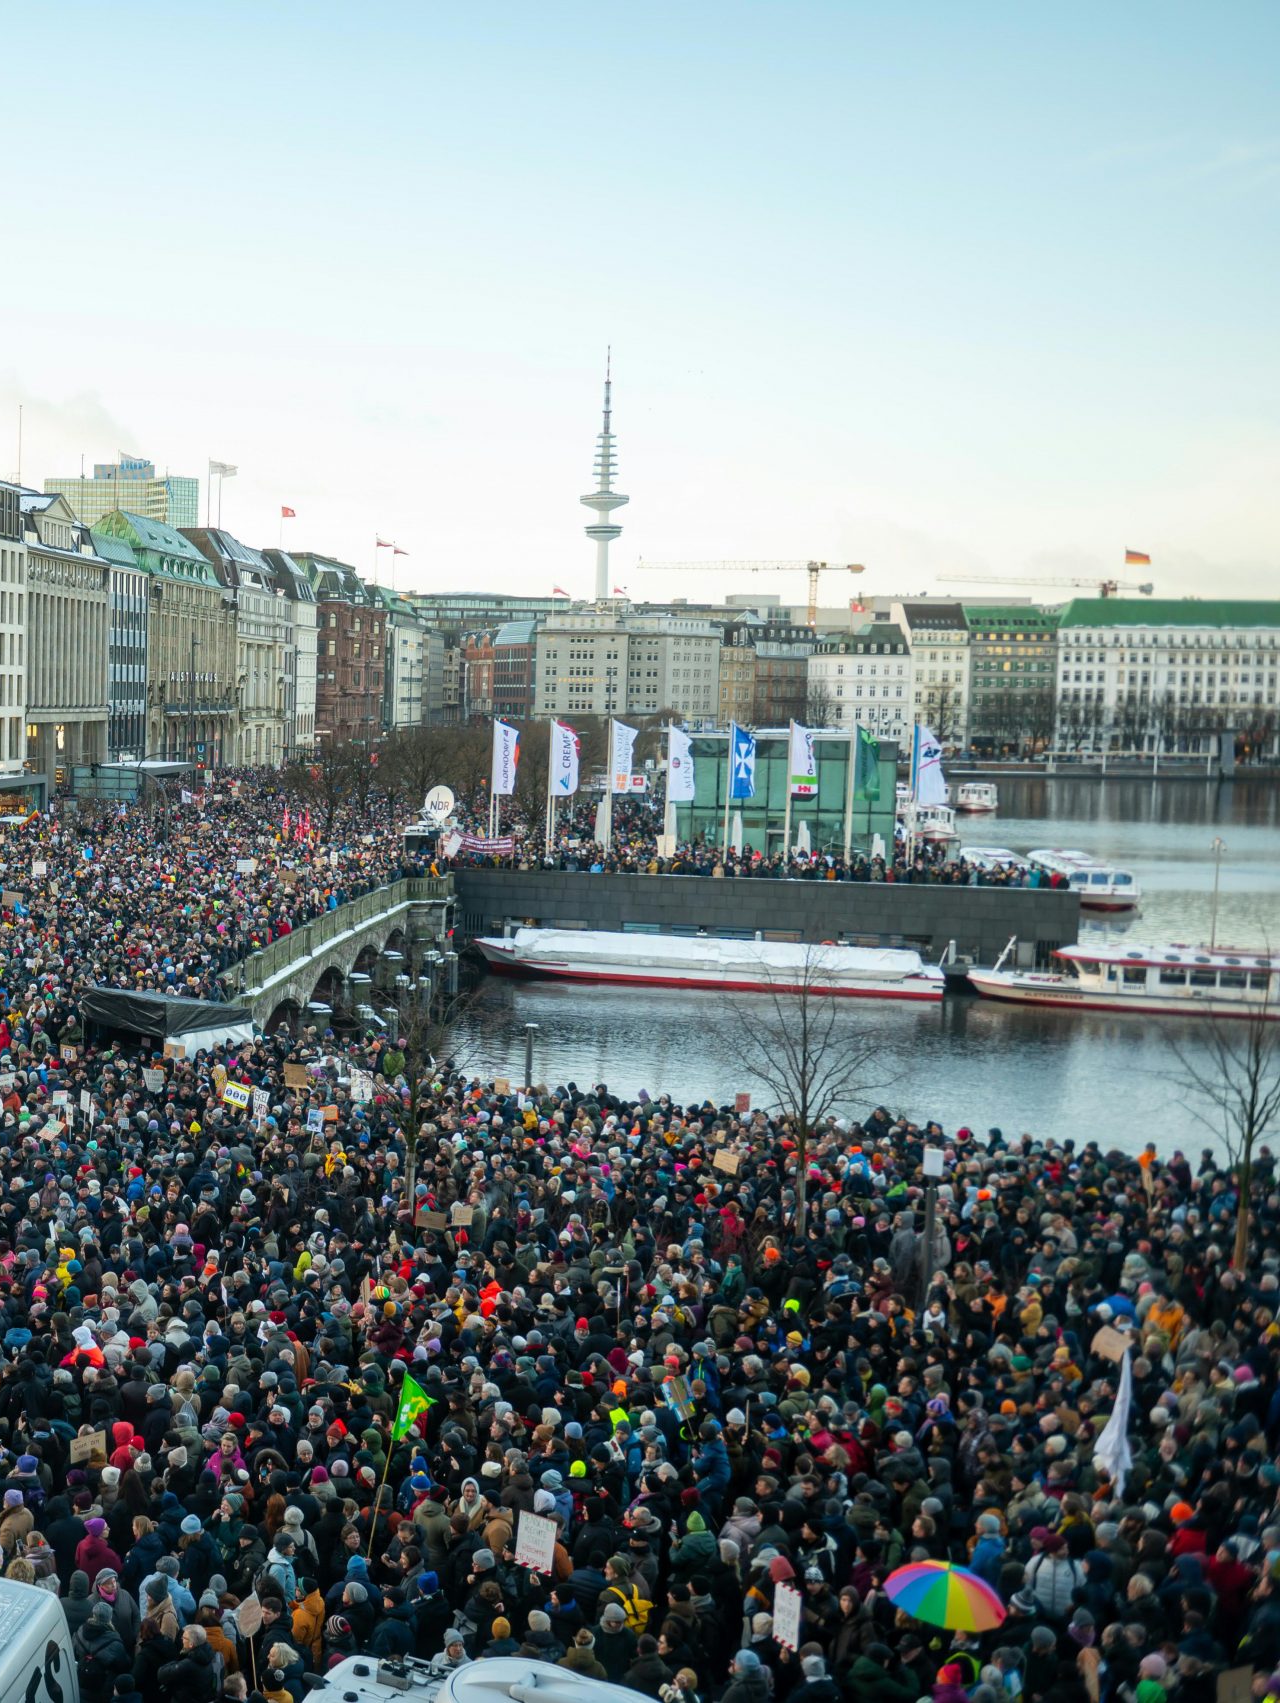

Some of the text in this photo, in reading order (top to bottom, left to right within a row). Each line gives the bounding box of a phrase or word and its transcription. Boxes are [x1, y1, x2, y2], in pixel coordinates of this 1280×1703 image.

[197, 744, 205, 753] U
[197, 754, 204, 762] S
[429, 800, 450, 811] NDR
